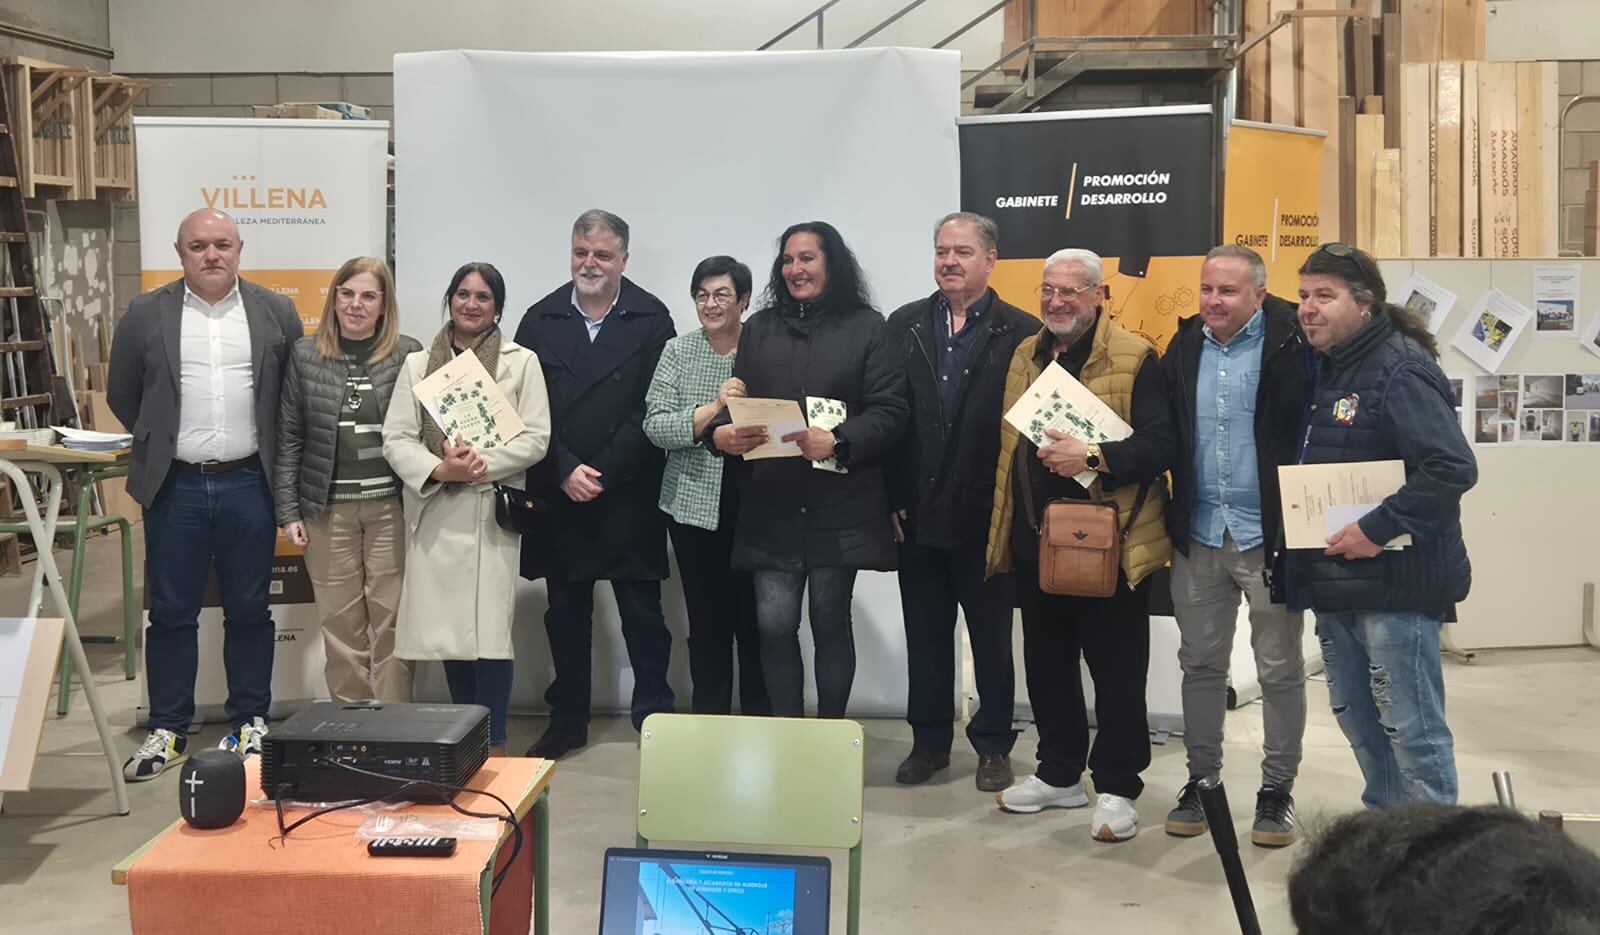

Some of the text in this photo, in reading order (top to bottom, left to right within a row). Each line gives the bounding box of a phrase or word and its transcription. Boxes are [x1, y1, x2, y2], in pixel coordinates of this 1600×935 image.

[1083, 170, 1170, 187] PROMOCIÓN
[200, 187, 328, 209] VILLENA
[995, 192, 1167, 208] GABINETE DESARROLLO
[260, 216, 326, 225] MEDITERRÁNEA
